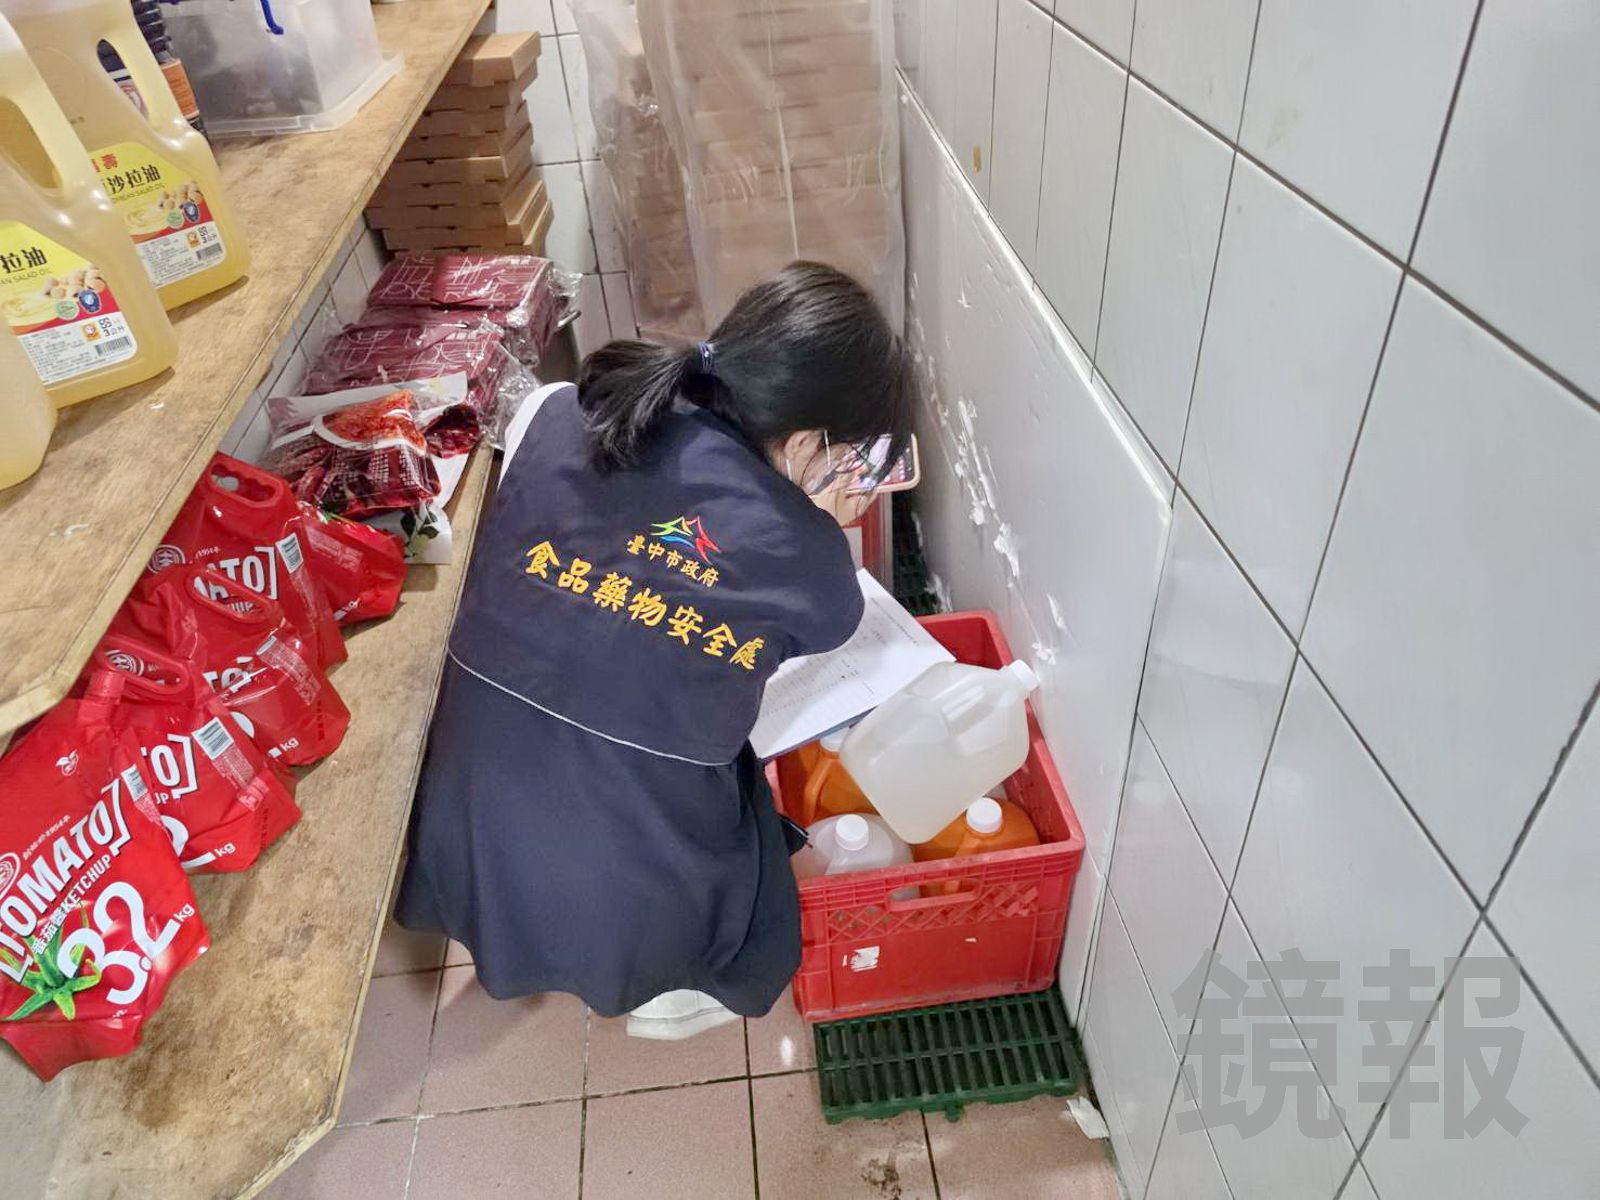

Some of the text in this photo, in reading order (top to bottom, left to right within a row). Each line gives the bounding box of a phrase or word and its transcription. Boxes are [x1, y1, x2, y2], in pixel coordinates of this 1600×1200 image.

[101, 164, 161, 195] 沙拉油
[214, 842, 236, 857] kg
[61, 854, 112, 914] KETCHUP
[57, 881, 195, 1005] 3.2 kg
